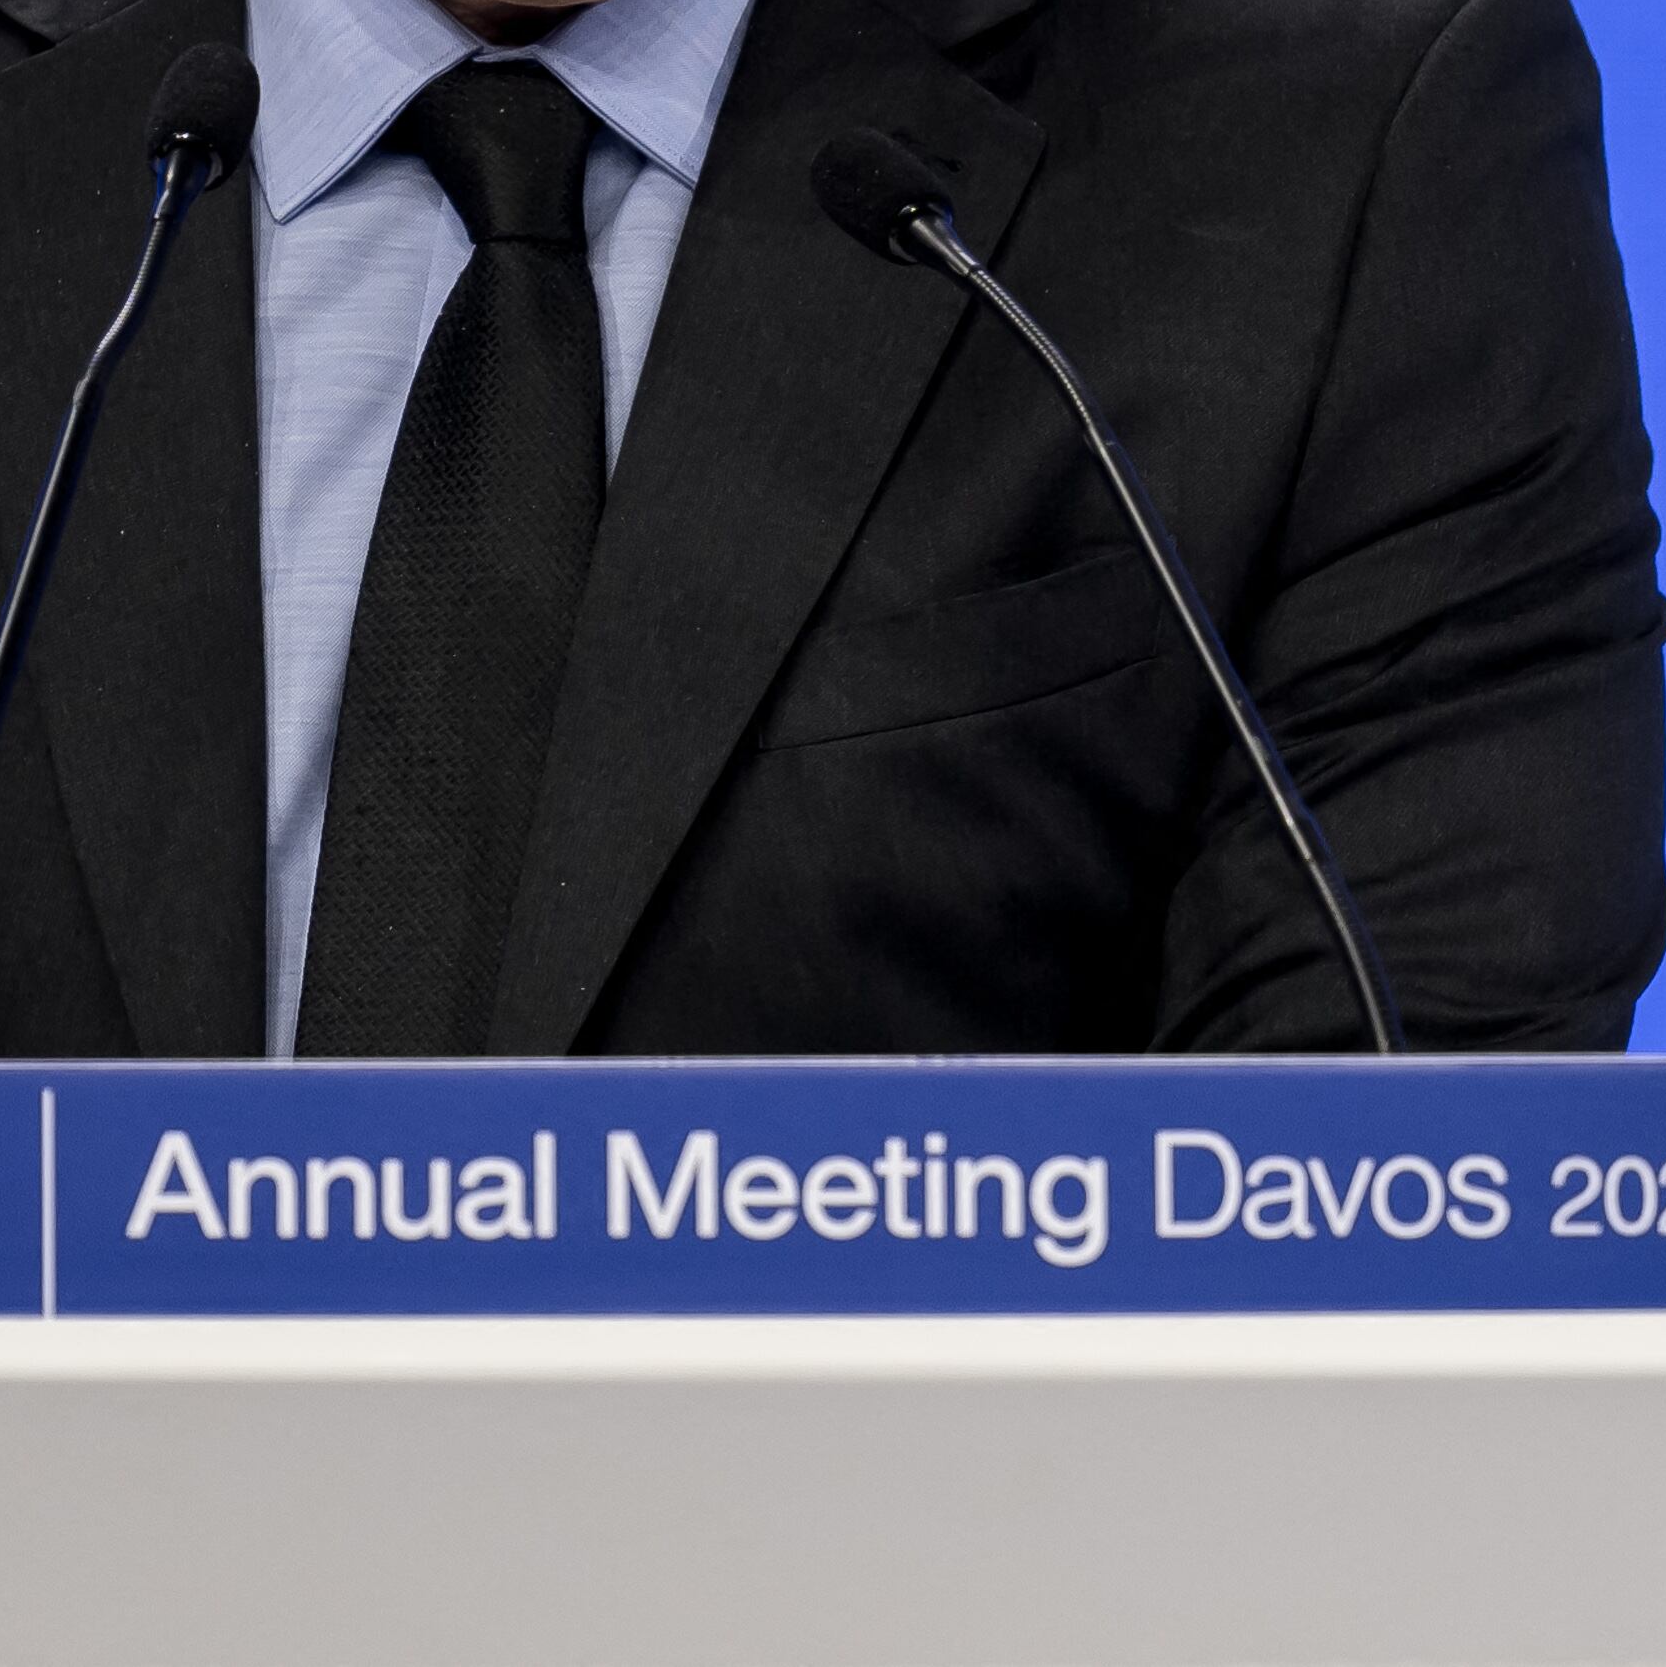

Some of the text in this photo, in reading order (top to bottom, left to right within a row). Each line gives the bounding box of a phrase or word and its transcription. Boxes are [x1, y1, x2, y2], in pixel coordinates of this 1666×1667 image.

[125, 1129, 560, 1242] Annual
[605, 1130, 1110, 1268] Meeting
[1153, 1130, 1511, 1242] Davos
